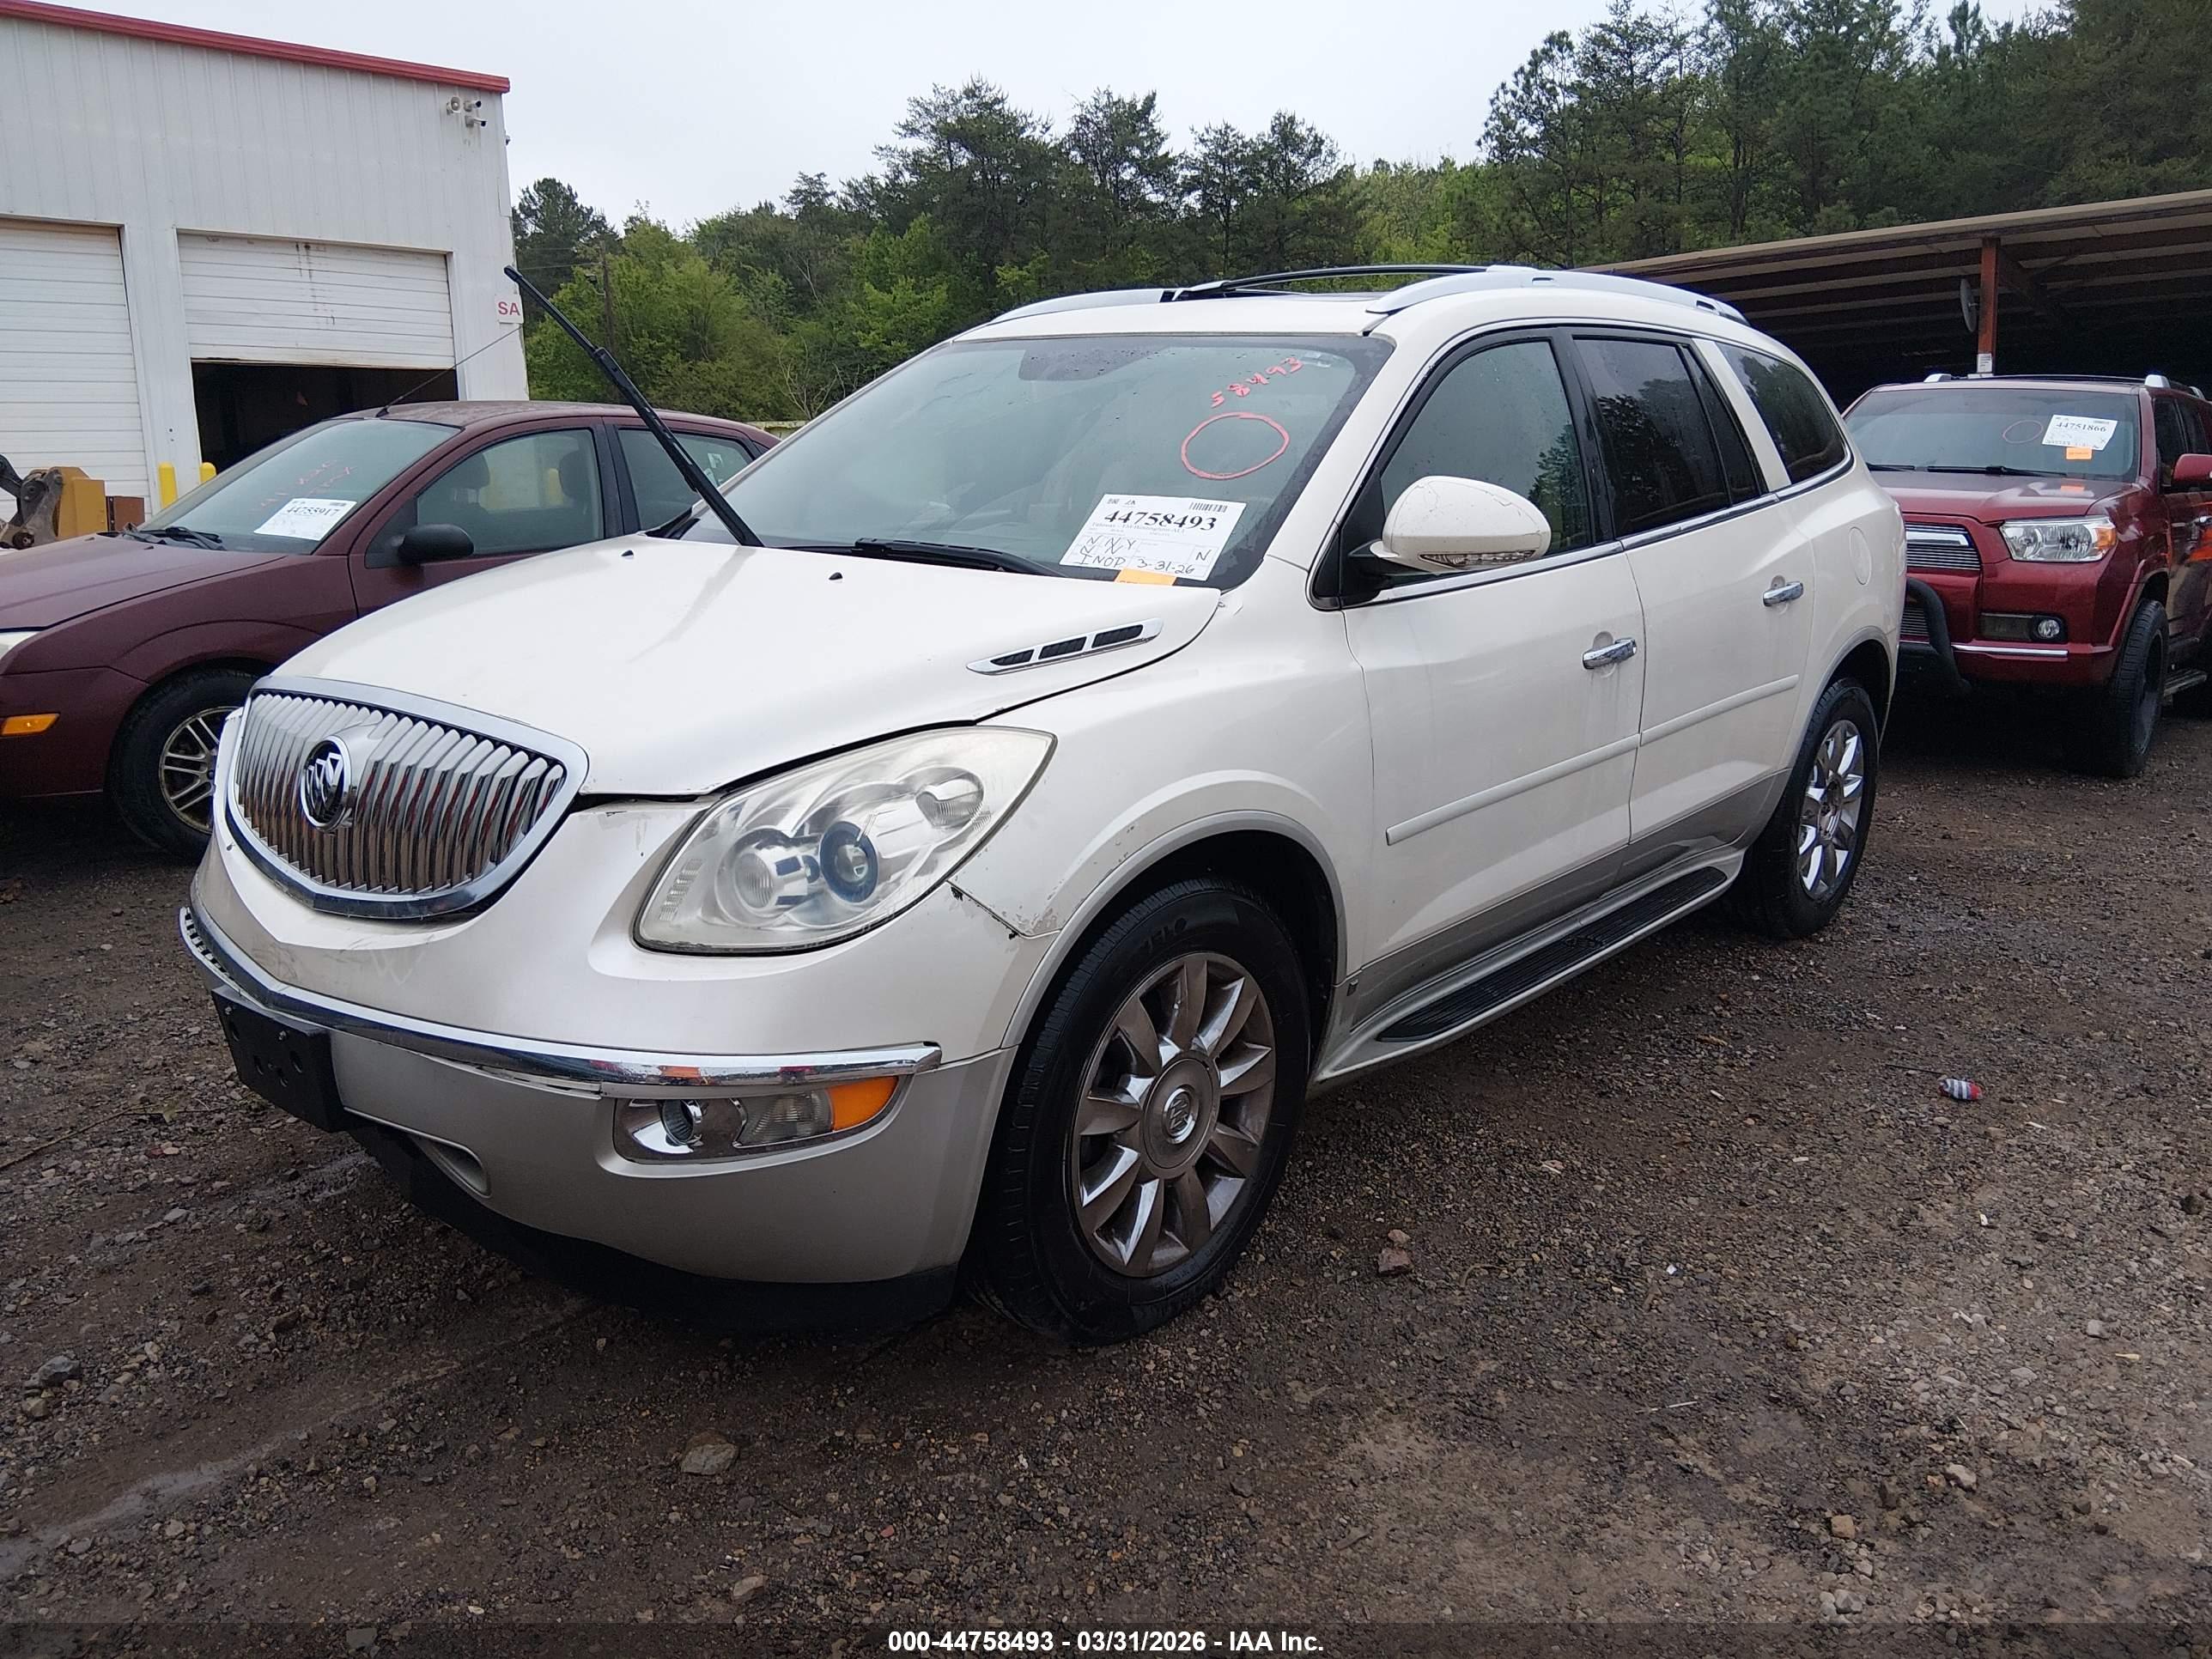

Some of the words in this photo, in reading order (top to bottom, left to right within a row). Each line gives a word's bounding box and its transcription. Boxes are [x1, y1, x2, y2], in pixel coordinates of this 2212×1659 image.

[498, 301, 520, 316] SA
[1104, 510, 1217, 532] 44758493
[1073, 553, 1126, 568] INOP
[1137, 558, 1194, 574] 3-31-26
